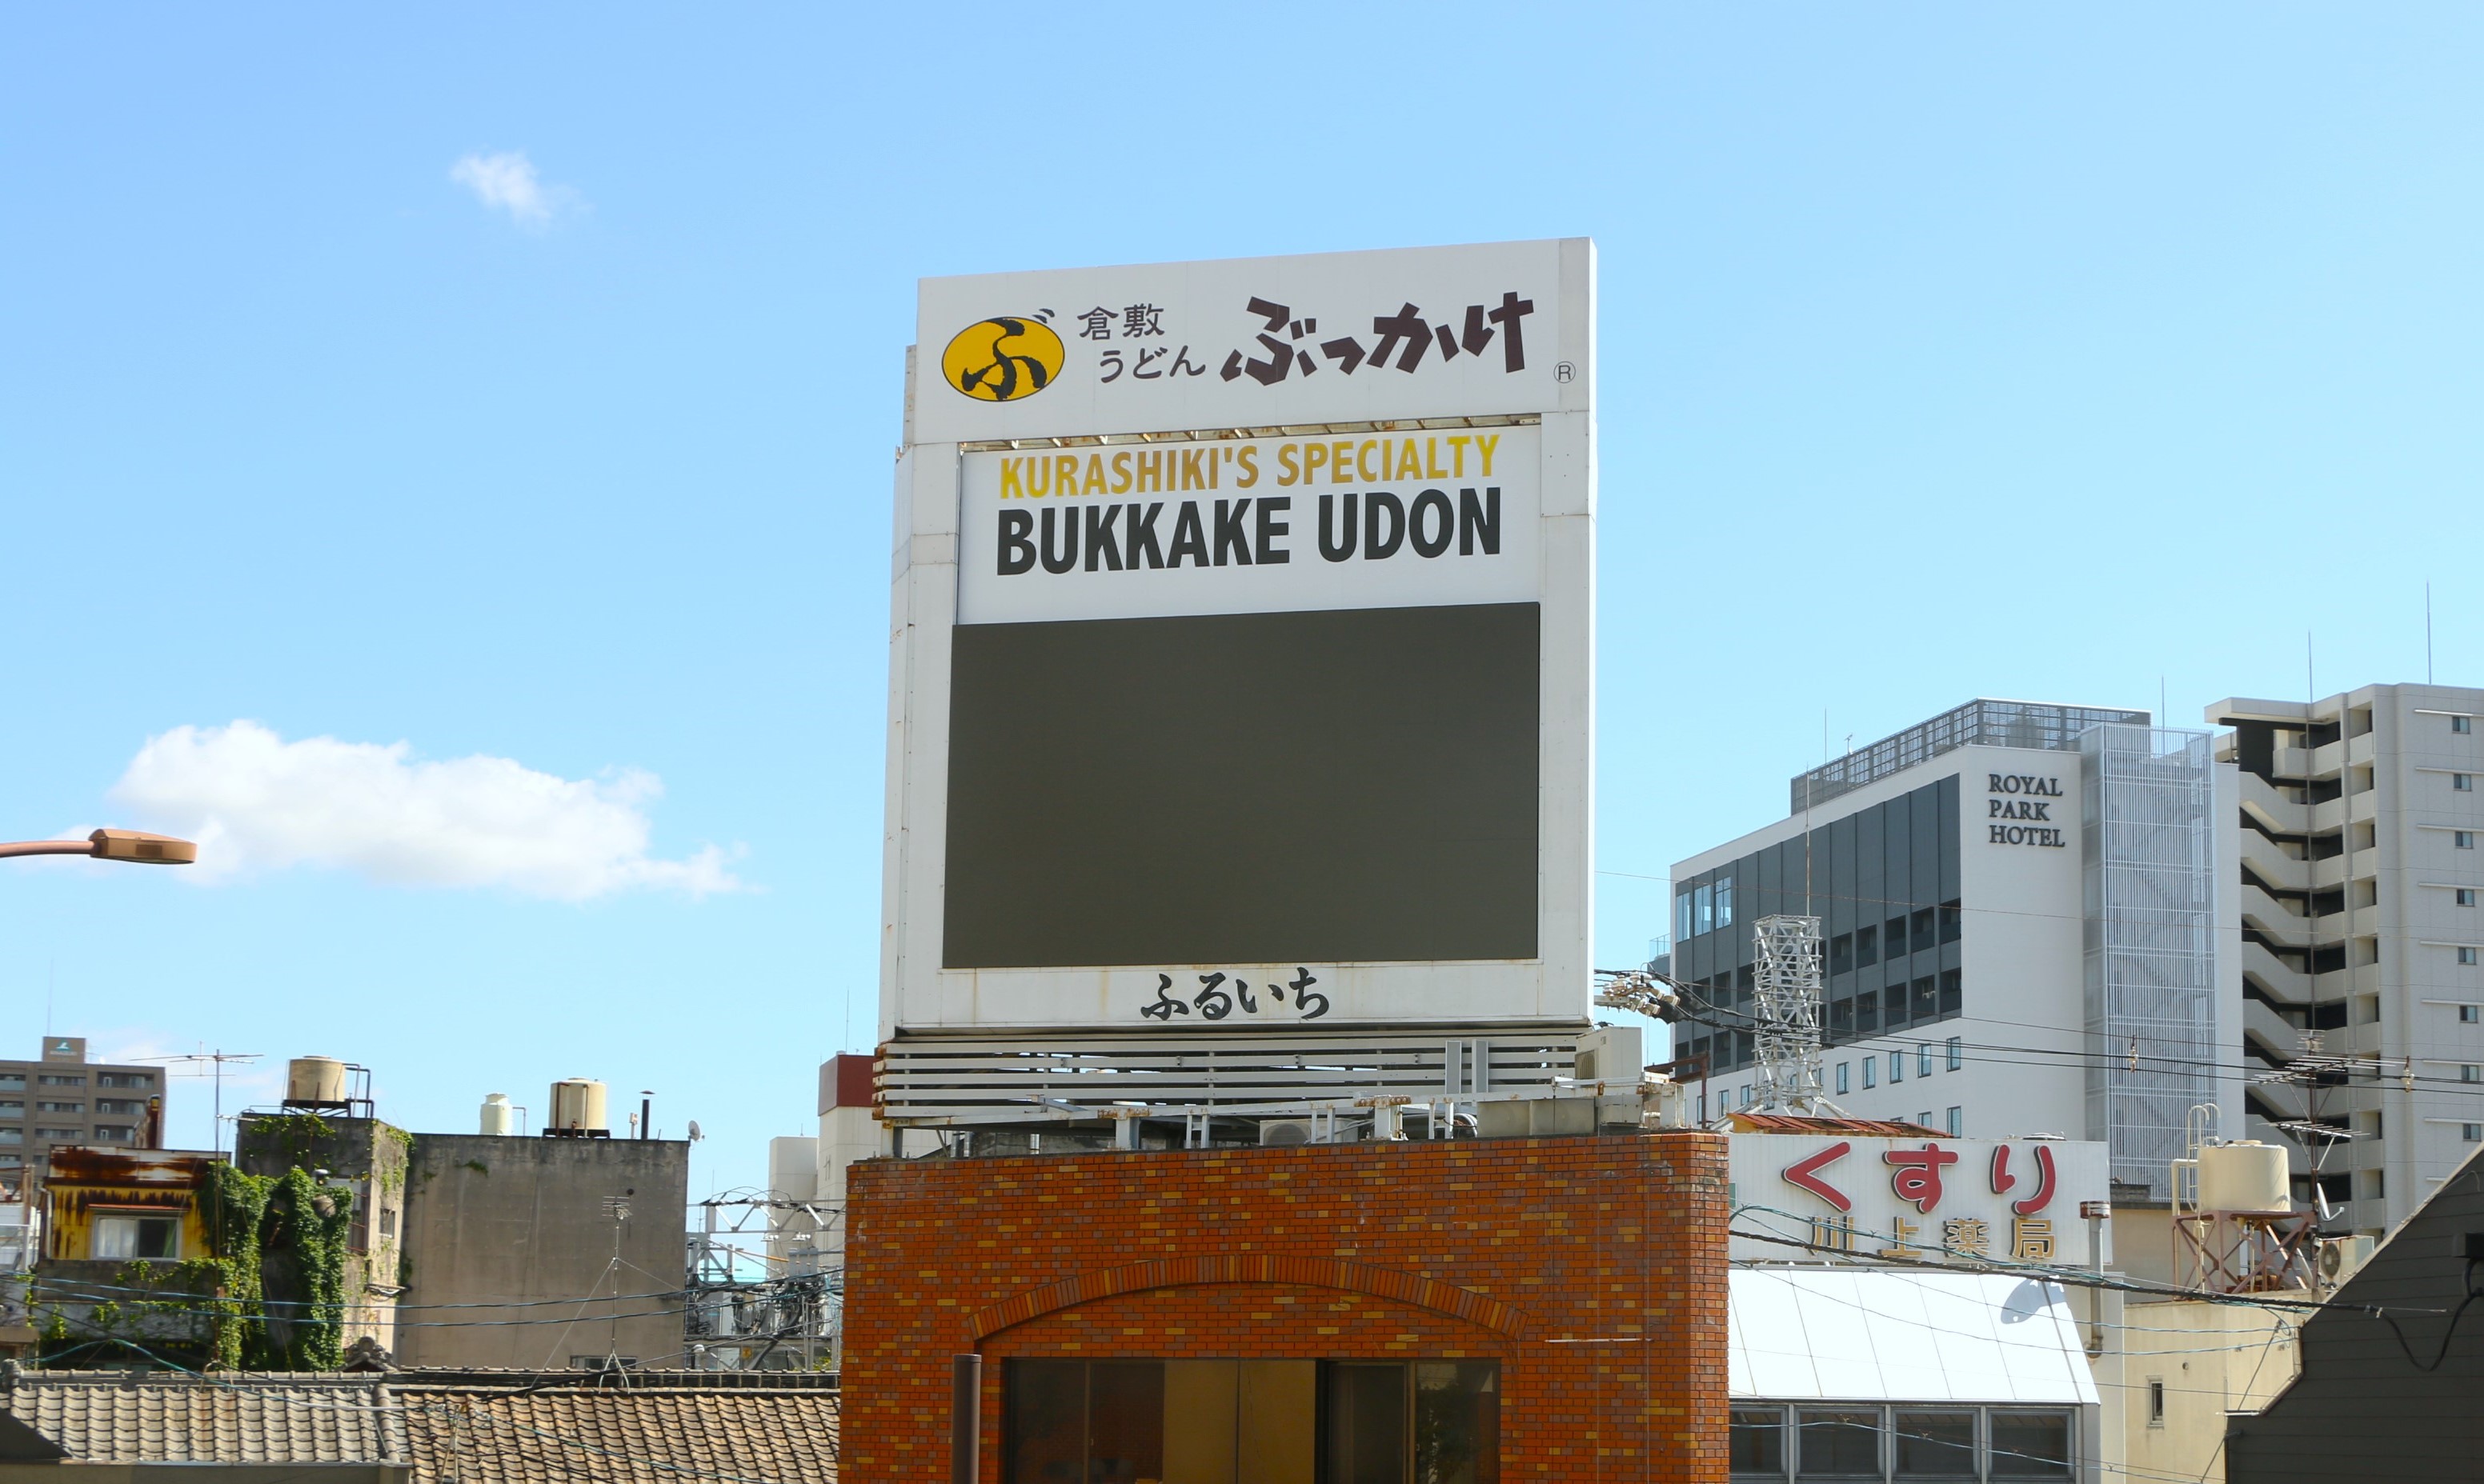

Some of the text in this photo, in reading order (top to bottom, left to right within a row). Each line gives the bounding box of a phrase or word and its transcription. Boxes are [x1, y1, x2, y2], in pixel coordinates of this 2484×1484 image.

[1077, 303, 1164, 340] 倉敷
[1220, 291, 1534, 386] ぶっかけ
[1100, 346, 1206, 382] うどん
[1000, 434, 1500, 499] KURASHIKI'S SPECIALTY
[997, 486, 1500, 575] BUKKAKE UDON
[1989, 774, 2063, 796] ROYAL
[1989, 799, 2050, 821] PARK
[1989, 825, 2065, 847] HOTEL
[1140, 967, 1329, 1021] ふるいち
[1781, 1142, 2056, 1214] くすり
[1812, 1216, 2055, 1259] 川上薬局
